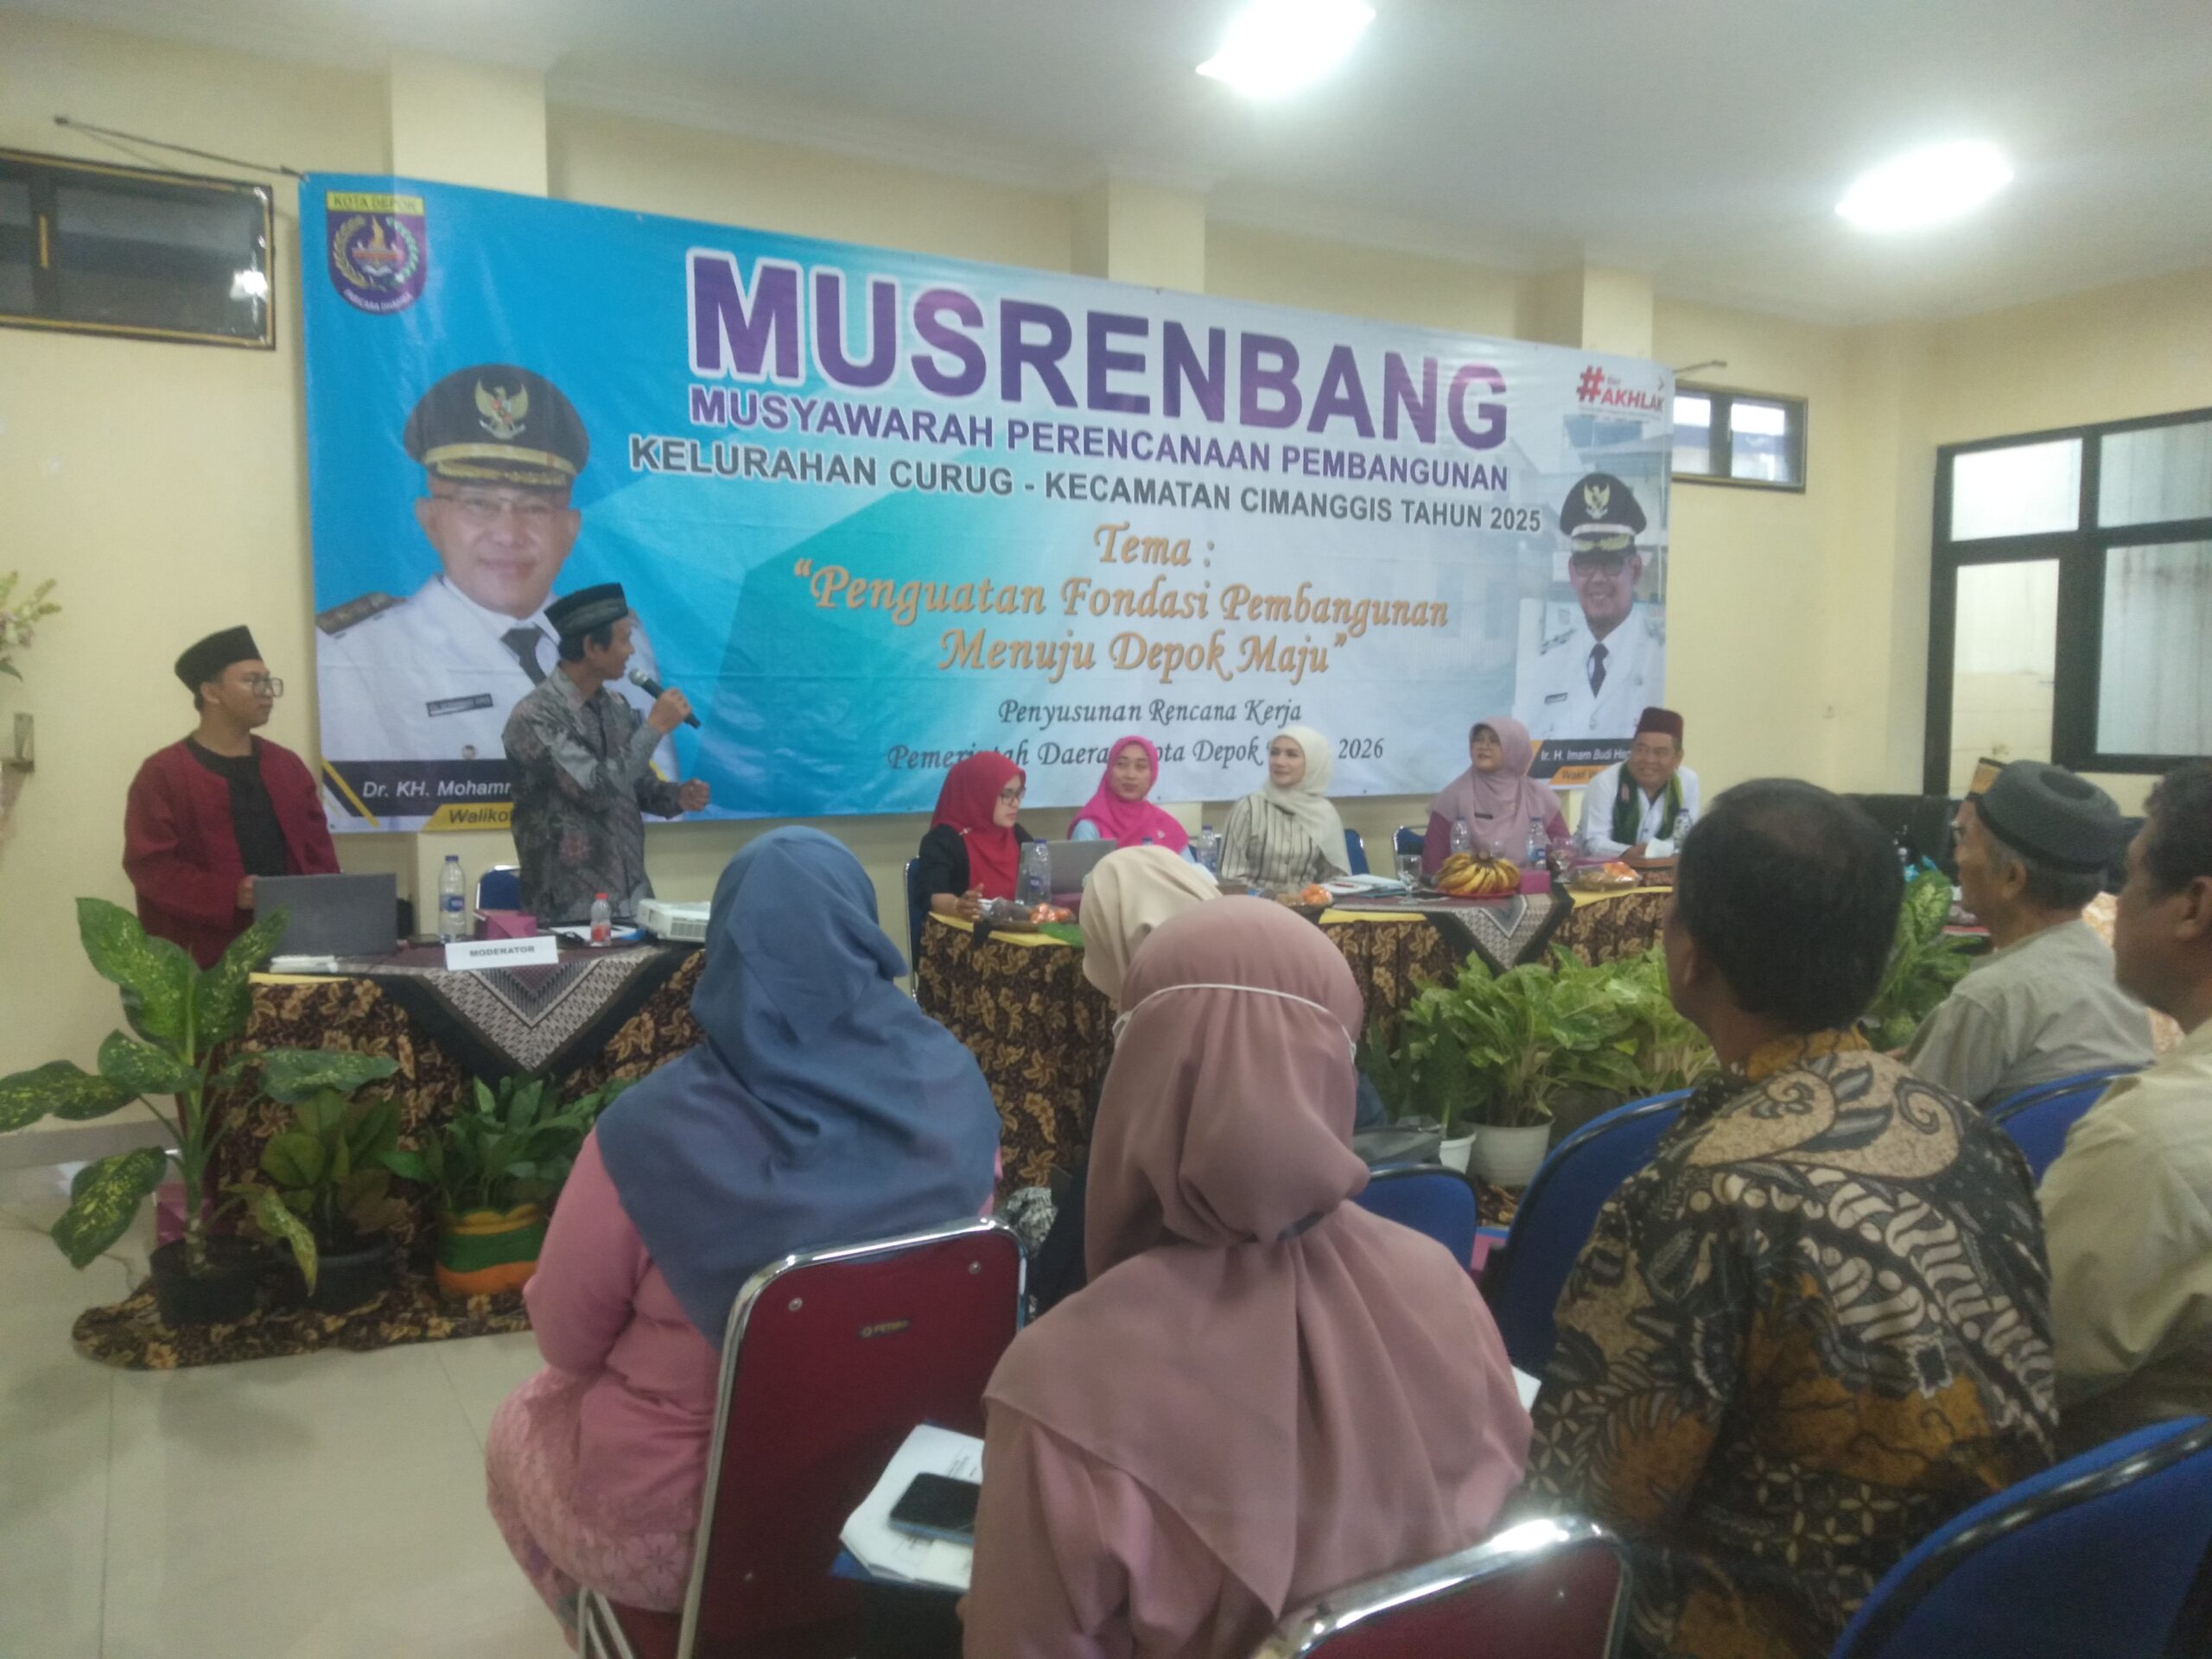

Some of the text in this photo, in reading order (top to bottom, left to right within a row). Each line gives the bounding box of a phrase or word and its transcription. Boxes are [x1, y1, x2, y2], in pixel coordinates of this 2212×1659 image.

[691, 254, 1508, 451] MUSRENBANG
[690, 386, 1508, 492] MUSYAWARAH PERENCANAAN PEMBANGUNAN
[631, 436, 876, 486] KELURAHAN
[889, 459, 1013, 495] CURUG
[1045, 470, 1230, 510] KECAMATAN
[1240, 486, 1393, 523] CIMANGGIS
[1400, 499, 1482, 528] TAHUN
[1490, 505, 1541, 532] 2025
[1093, 520, 1192, 567] Tema
[1060, 574, 1209, 620] Fondasi
[1219, 581, 1448, 639] Pembangunan
[938, 627, 1096, 684] Menuju
[1108, 628, 1233, 684] Depok
[998, 698, 1302, 731] Penyusunan Rencana Kerja
[1038, 741, 1109, 766] Daera
[1151, 741, 1185, 762] ota
[1192, 736, 1264, 769] Depok
[1338, 737, 1385, 760] 2026
[1567, 749, 1592, 760] Imam
[1593, 747, 1613, 760] Budi
[363, 780, 389, 798] Dr.
[396, 779, 430, 797] KH.
[448, 808, 512, 824] Waliko
[469, 945, 535, 957] MODERATOR
